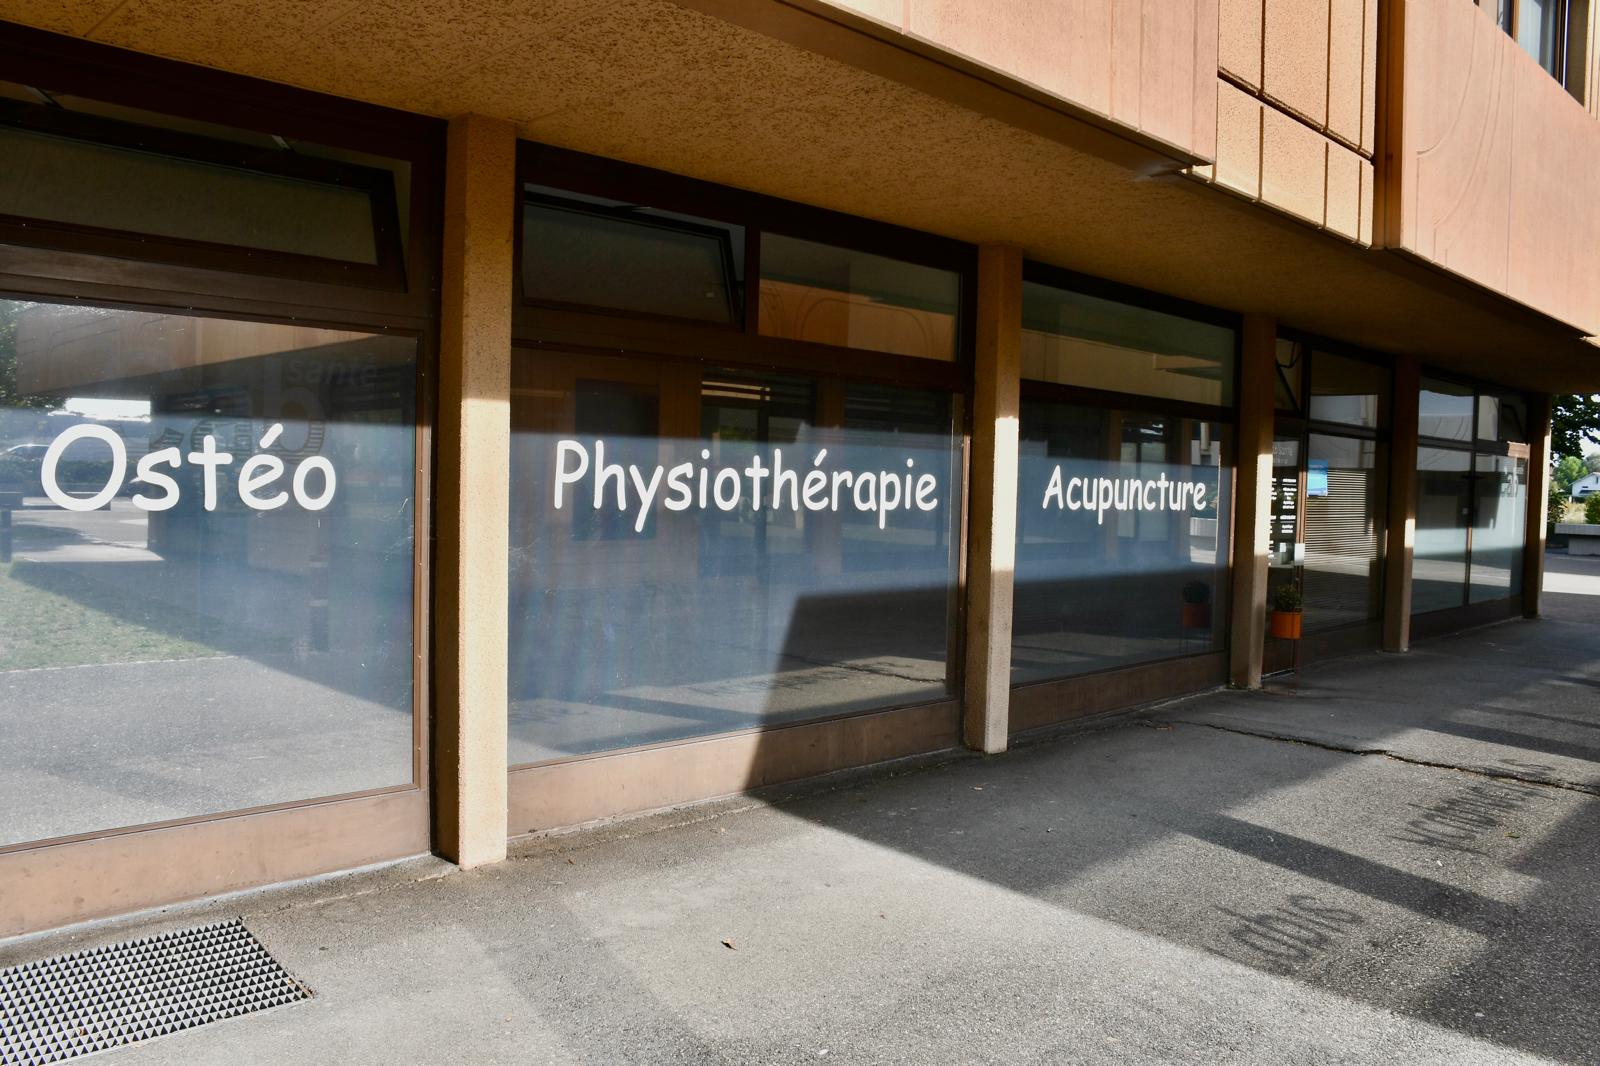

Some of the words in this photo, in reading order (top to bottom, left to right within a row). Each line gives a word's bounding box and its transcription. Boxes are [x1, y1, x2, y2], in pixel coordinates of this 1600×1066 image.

[40, 422, 337, 512] Ostéo
[553, 439, 938, 533] Physiothérapie
[1042, 464, 1207, 526] Acupuncture
